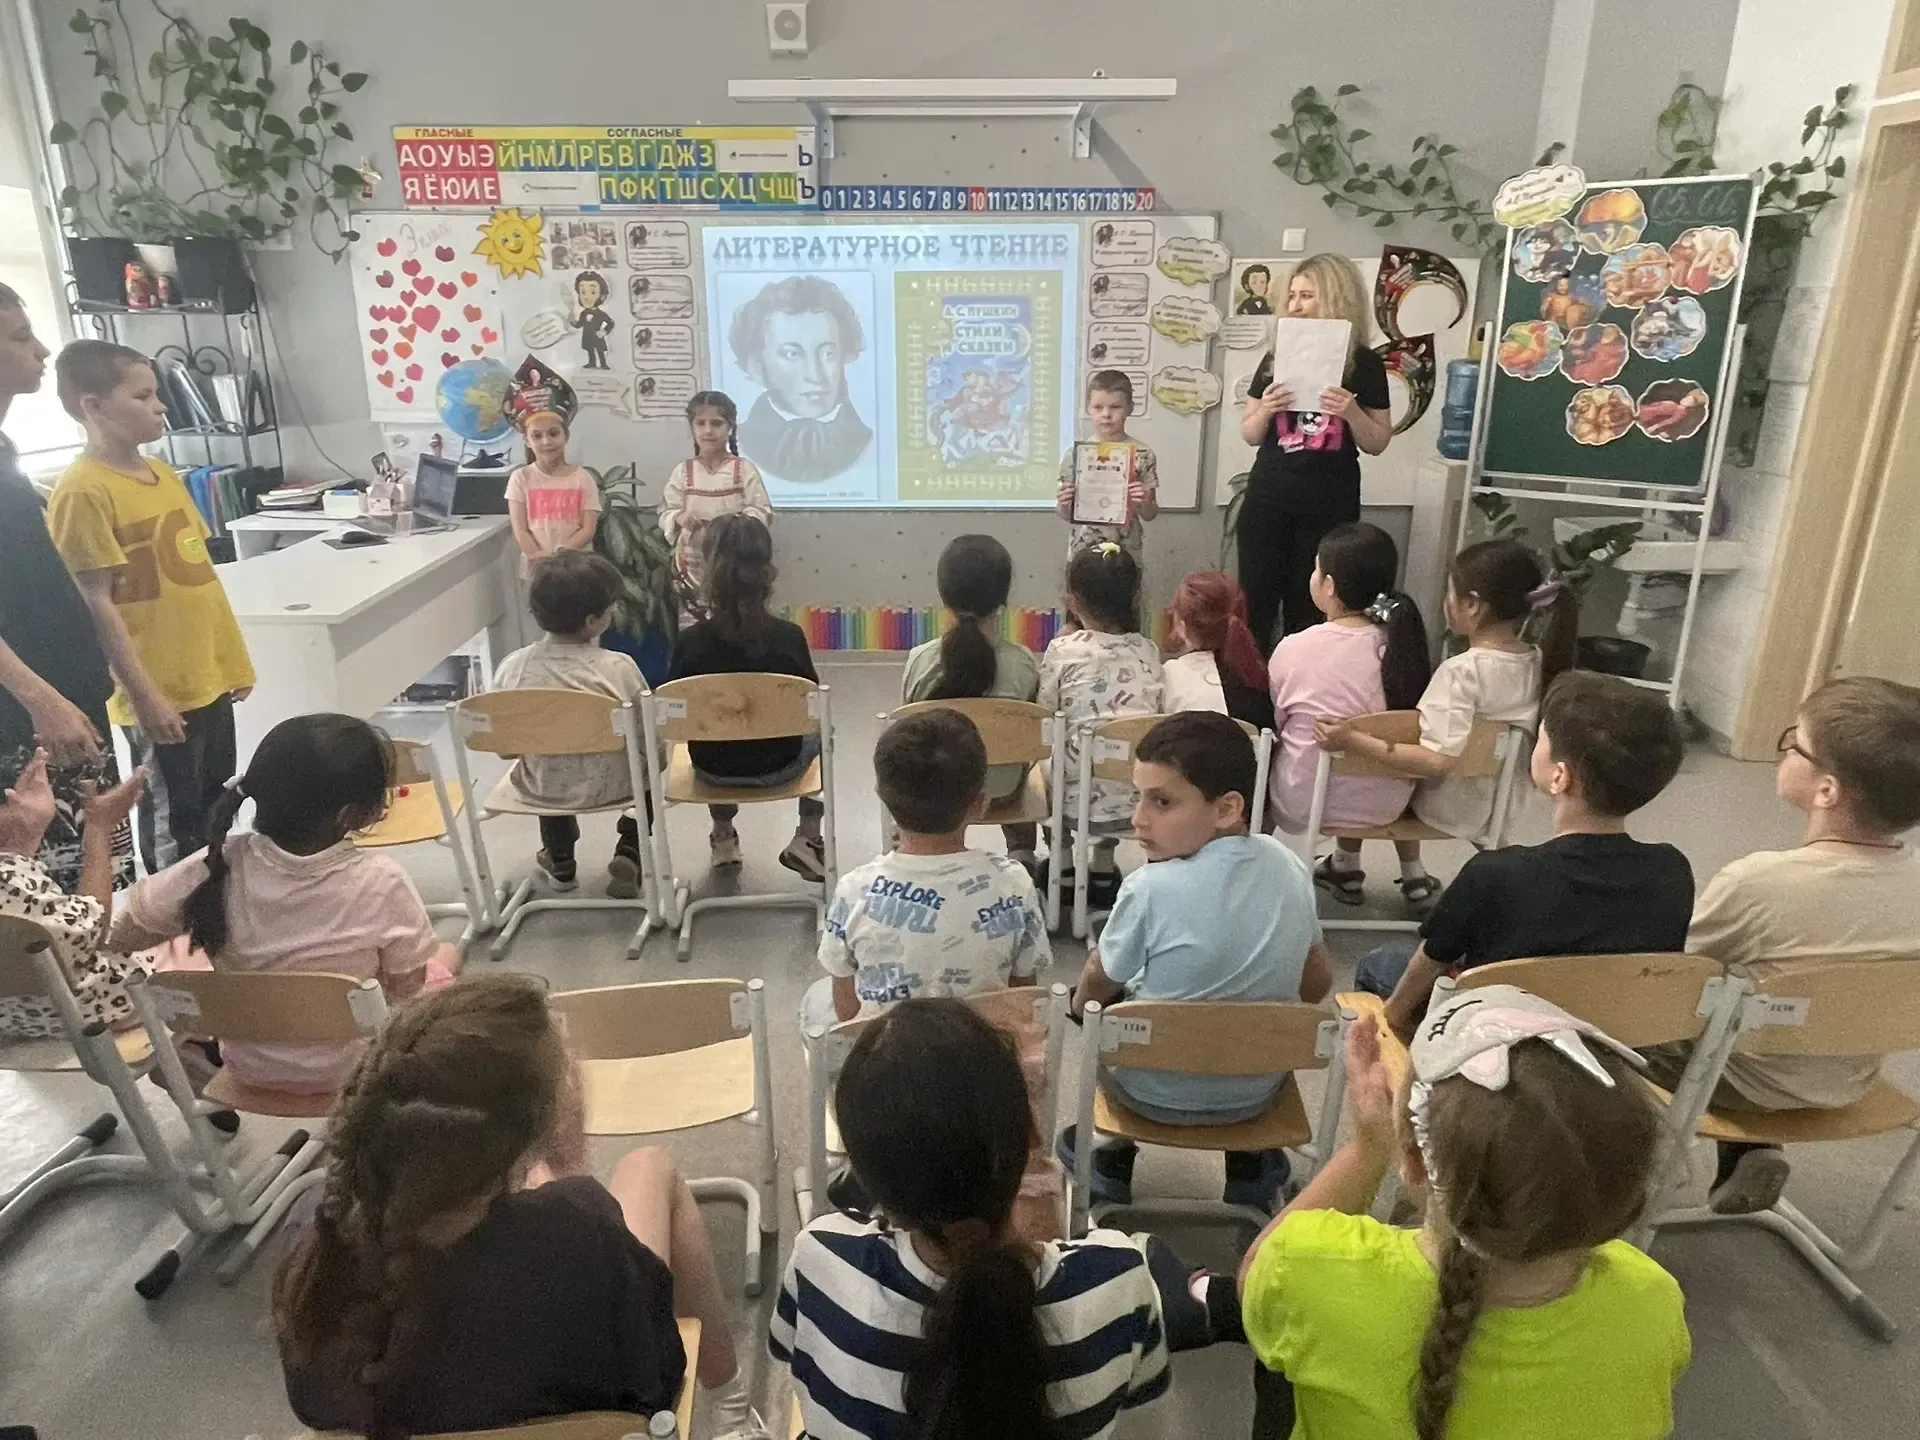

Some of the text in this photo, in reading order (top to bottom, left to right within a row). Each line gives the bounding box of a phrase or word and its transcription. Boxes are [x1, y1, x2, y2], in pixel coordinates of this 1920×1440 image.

[415, 128, 474, 137] ГЛАСНЫЕ
[607, 128, 683, 138] СОГЛАСНЫЕ
[822, 190, 1153, 210] 0 1 2 3 4 5 6 7 8 9 10 11 12 13 14 15 16 17 18 19 20
[713, 235, 940, 258] ЛИТЕРАТУРНОЕ
[950, 235, 1069, 257] ЧТЕНИЕ
[967, 307, 1017, 316] ПУШКИН
[955, 326, 1002, 337] СТИХИ
[959, 342, 1013, 352] СКАЗКИ
[870, 875, 945, 910] EXPLORE
